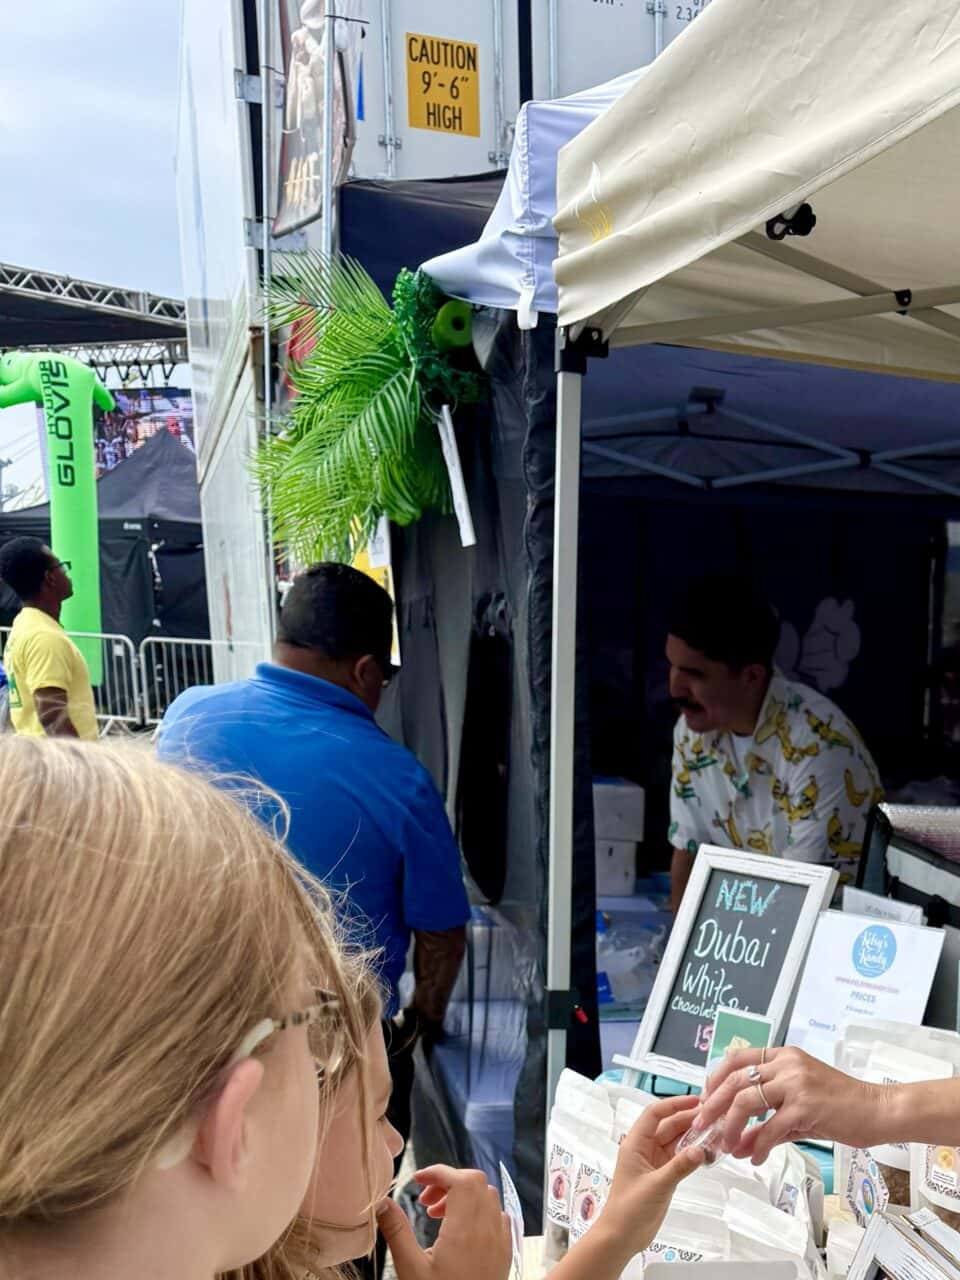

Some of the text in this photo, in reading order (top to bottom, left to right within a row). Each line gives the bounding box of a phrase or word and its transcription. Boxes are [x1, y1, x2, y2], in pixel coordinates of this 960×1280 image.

[408, 37, 477, 72] CAUTION
[426, 101, 463, 131] HIGH
[50, 360, 76, 487] GLOVIS
[714, 878, 781, 917] NEW
[693, 918, 778, 968] Dubai
[682, 961, 734, 1007] White
